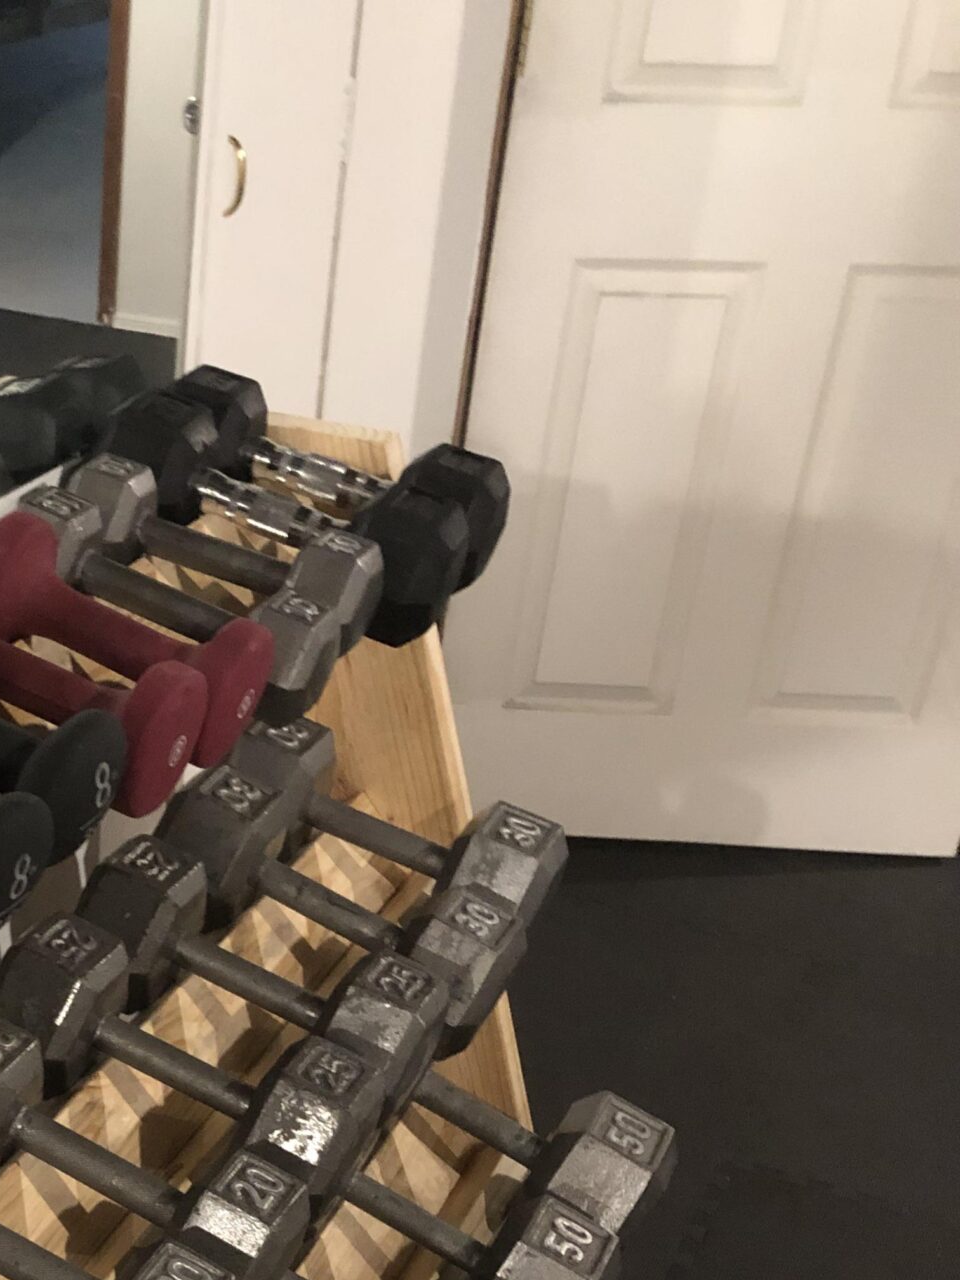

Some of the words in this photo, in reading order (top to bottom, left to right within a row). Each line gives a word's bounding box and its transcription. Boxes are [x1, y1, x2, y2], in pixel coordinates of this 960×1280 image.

[95, 761, 112, 808] 8
[500, 817, 541, 848] 30
[9, 852, 32, 900] 8
[455, 902, 500, 937] 30
[380, 965, 426, 1001] 25
[311, 1052, 357, 1093] 25
[606, 1110, 653, 1155] 50
[232, 1167, 286, 1212] 20
[544, 1216, 594, 1262] 50
